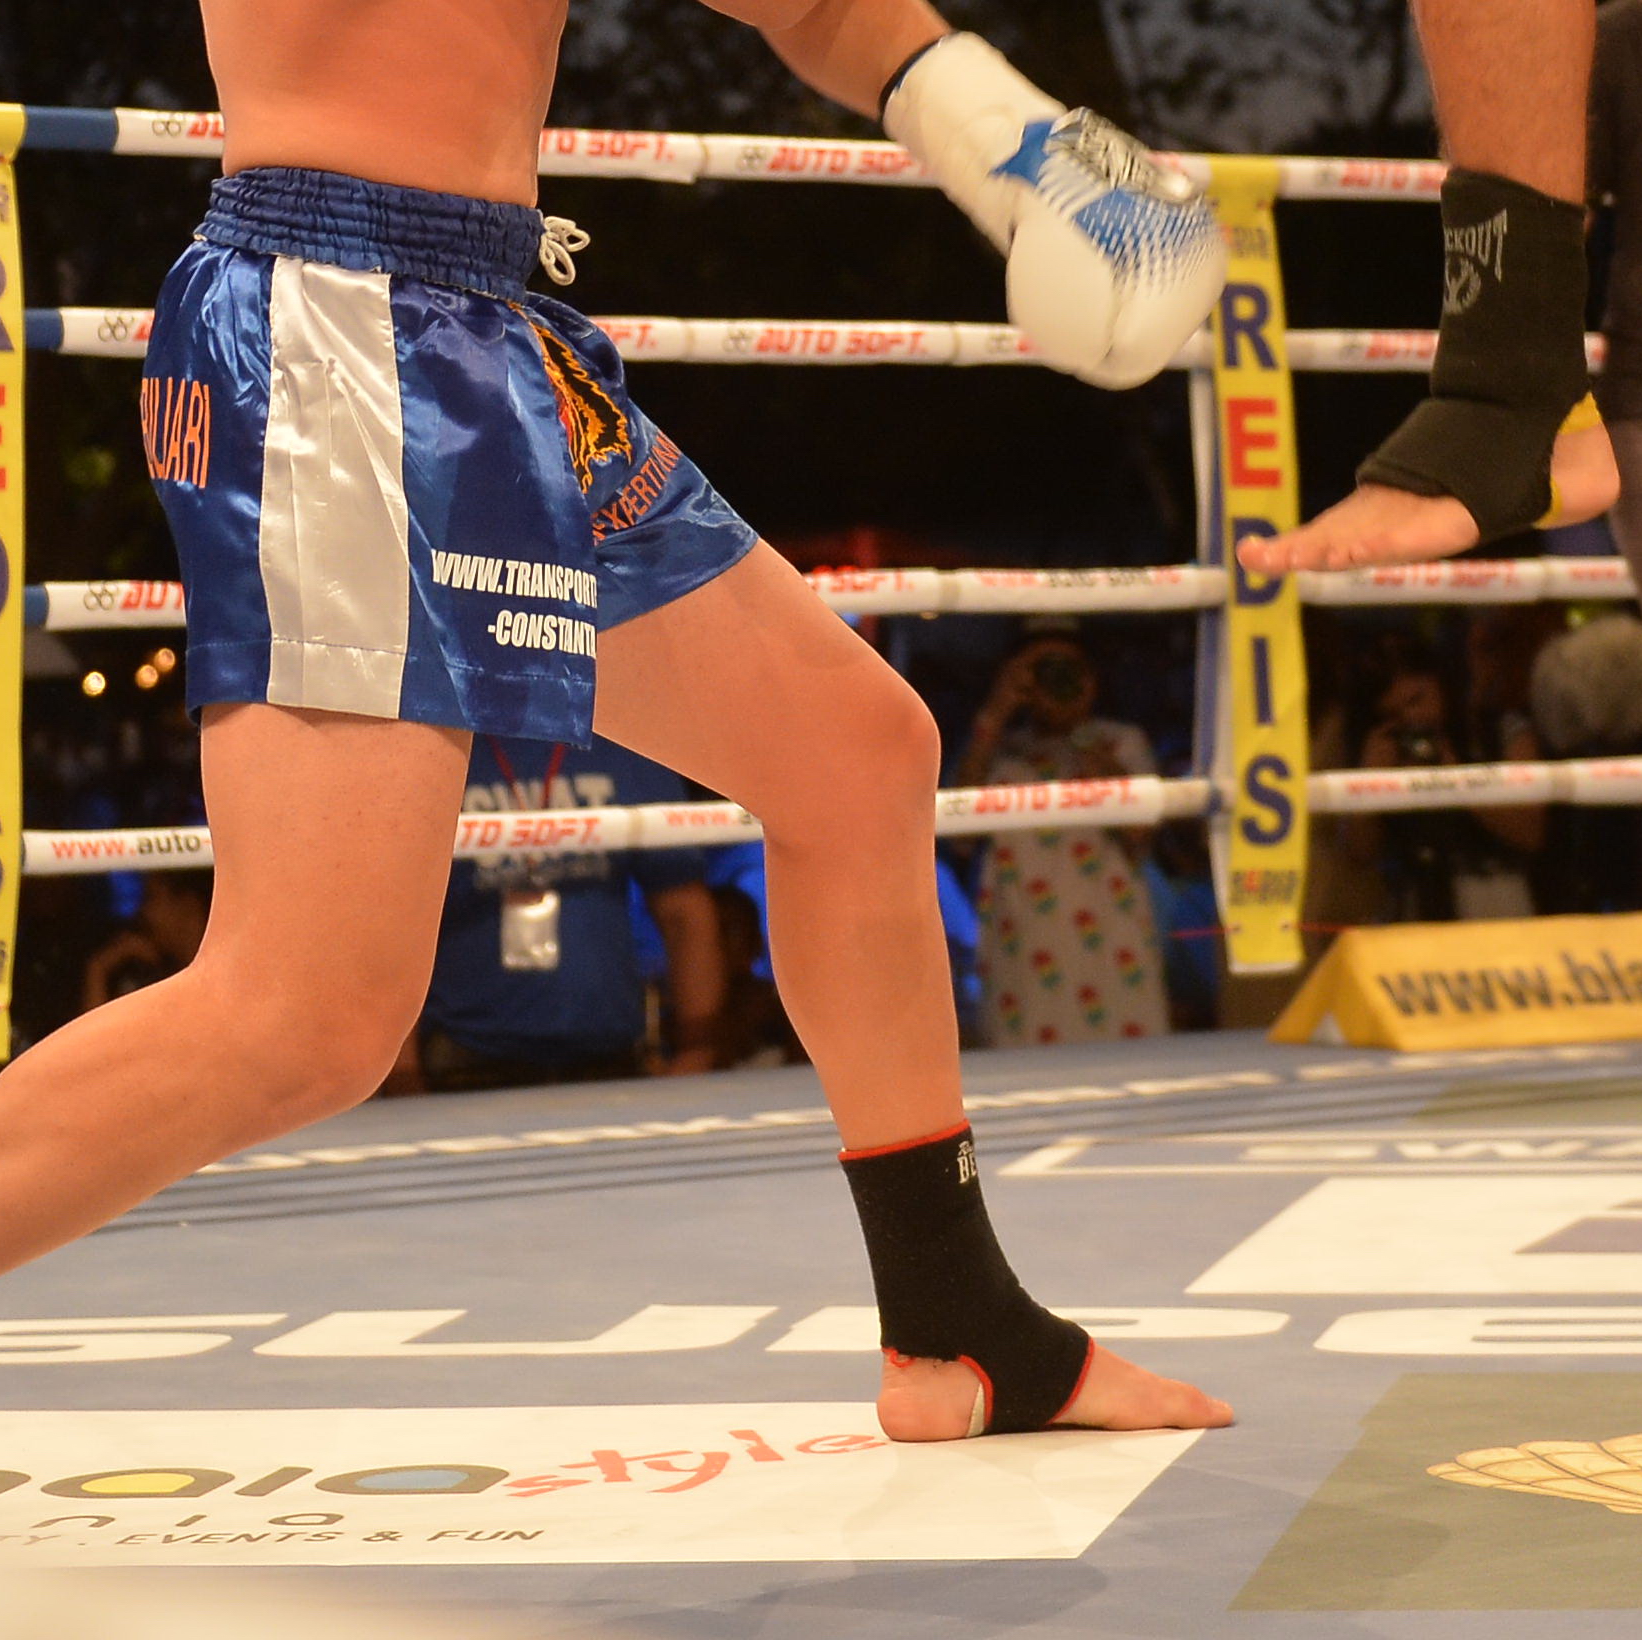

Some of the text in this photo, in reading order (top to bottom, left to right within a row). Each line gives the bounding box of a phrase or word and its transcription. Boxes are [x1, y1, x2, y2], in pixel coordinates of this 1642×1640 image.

[1444, 207, 1508, 283] CKOUT
[756, 328, 927, 356] AUTO SOFT
[431, 548, 598, 610] WWW.TRANSPORT
[1220, 282, 1295, 847] REDIS
[119, 581, 185, 611] AUT
[50, 833, 213, 860] www.auto-
[113, 1530, 345, 1546] EVENTS
[362, 1530, 401, 1543] &
[426, 1529, 546, 1543] FUN
